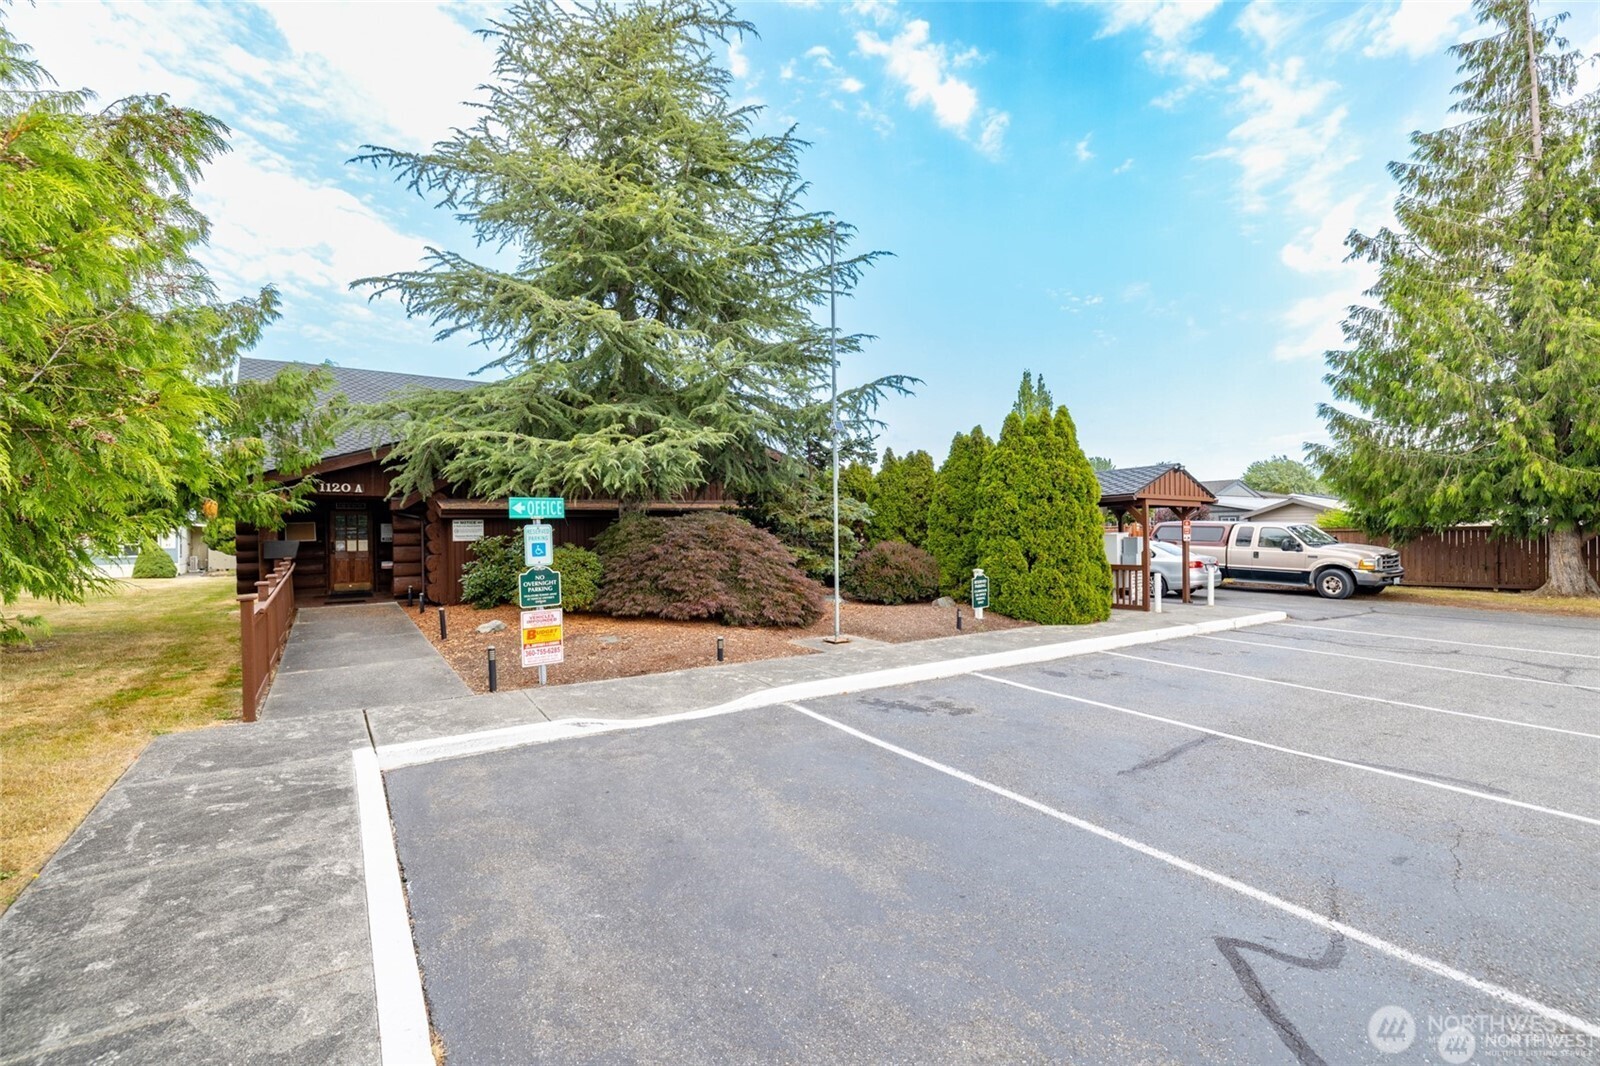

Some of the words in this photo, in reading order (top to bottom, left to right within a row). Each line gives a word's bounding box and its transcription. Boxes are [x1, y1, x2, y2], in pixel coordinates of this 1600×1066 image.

[320, 483, 351, 493] 1120
[355, 484, 363, 493] A
[527, 500, 562, 516] OFFICE
[522, 580, 557, 588] OVERNIGHT
